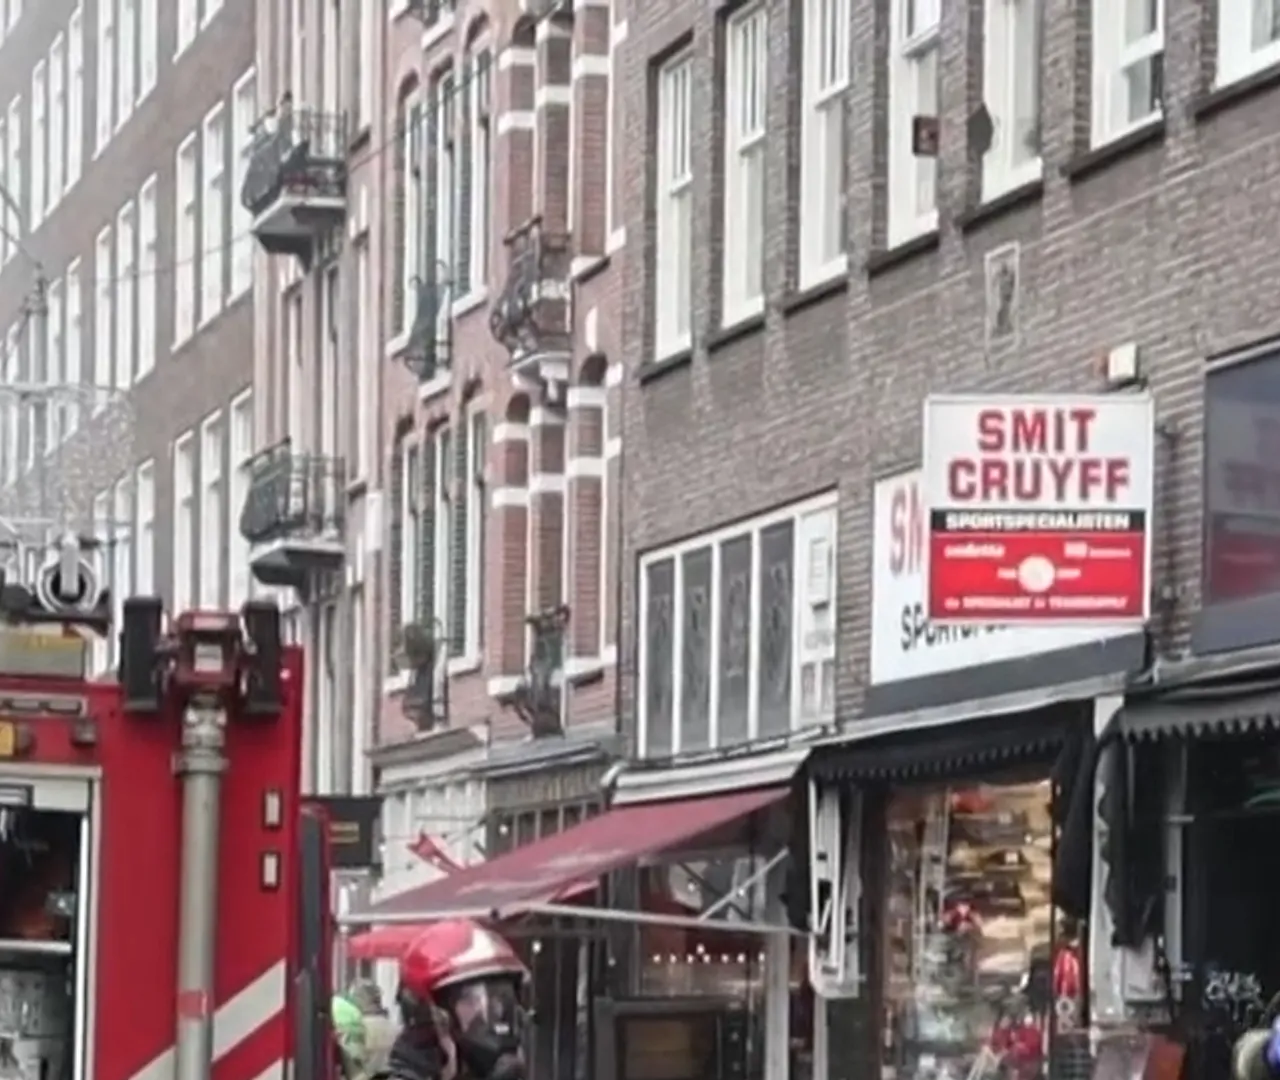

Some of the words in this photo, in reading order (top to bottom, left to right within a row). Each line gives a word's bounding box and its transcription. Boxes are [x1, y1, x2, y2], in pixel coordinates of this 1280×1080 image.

[977, 409, 1096, 453] SMIT
[948, 457, 1131, 501] CRUYFF
[945, 513, 1130, 531] SPORTSPECIALISTEN
